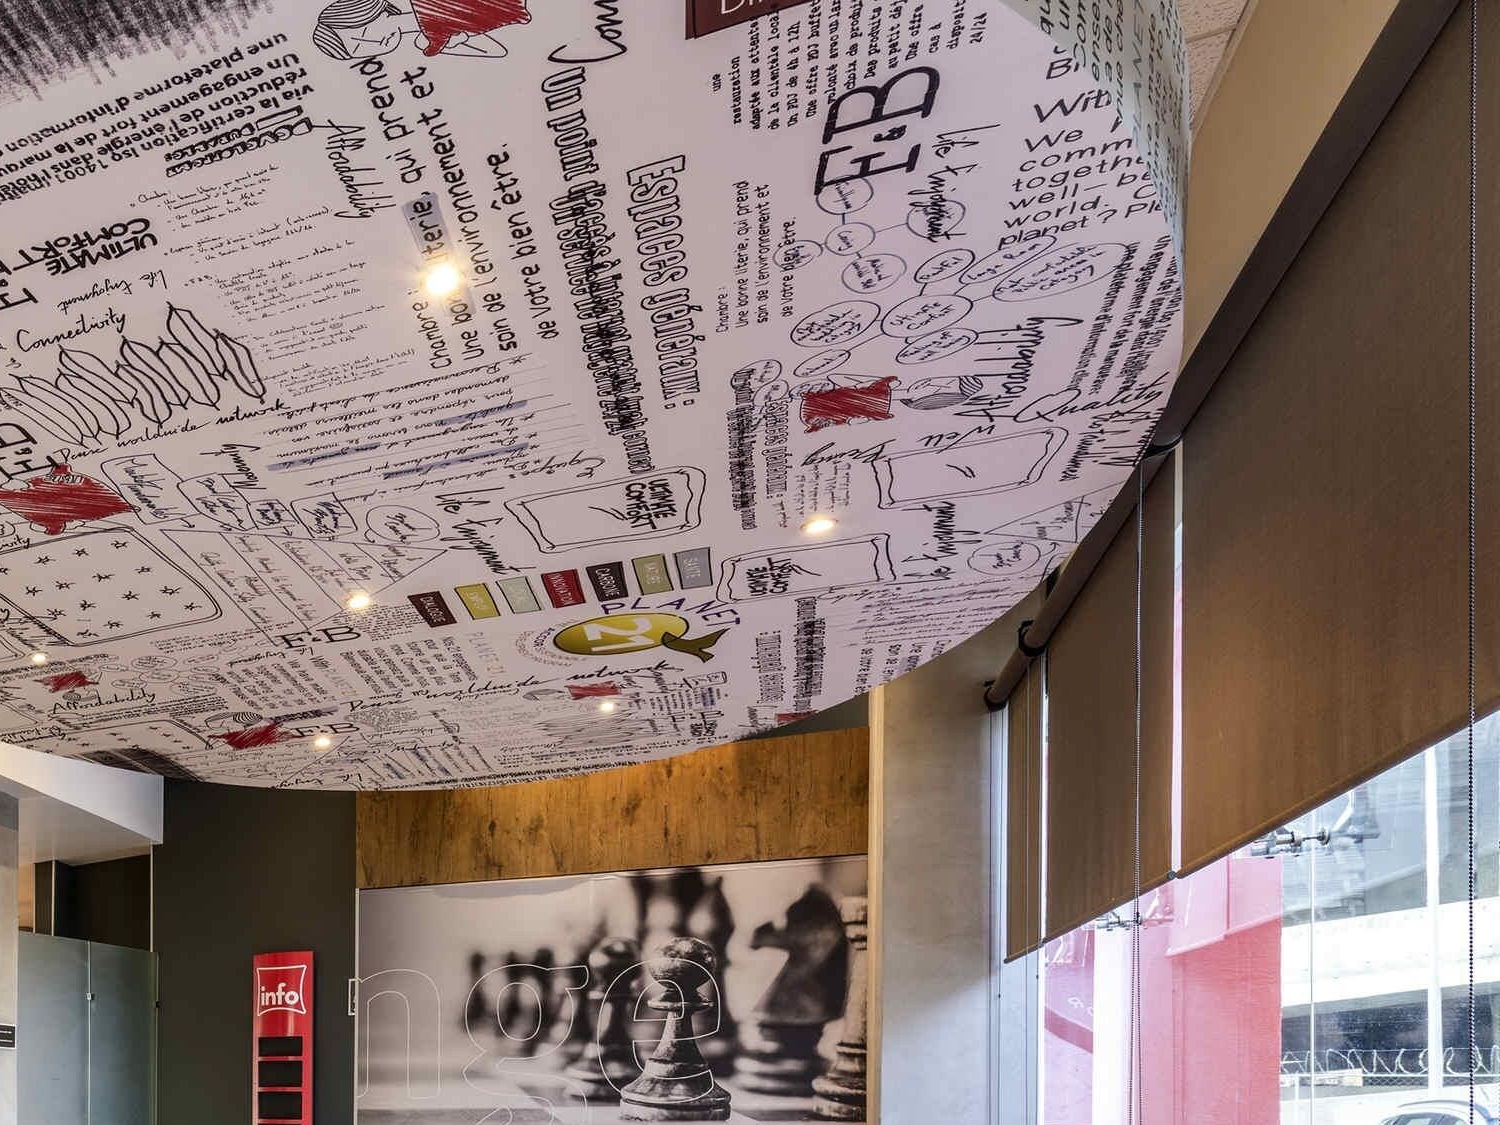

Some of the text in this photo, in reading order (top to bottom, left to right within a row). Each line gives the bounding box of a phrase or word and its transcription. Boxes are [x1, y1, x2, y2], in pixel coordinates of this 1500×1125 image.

[246, 33, 288, 55] une
[266, 53, 300, 69] Un
[133, 46, 242, 100] plateforme
[208, 67, 307, 111] réduction
[281, 84, 314, 100] via
[138, 67, 266, 123] engagement
[258, 96, 280, 109] la
[4, 96, 131, 155] d'information
[101, 117, 138, 141] fort
[137, 98, 255, 151] certification
[179, 108, 205, 122] de
[54, 141, 76, 154] la
[74, 133, 97, 146] de
[109, 142, 139, 162] Iso
[1024, 129, 1083, 152] We
[323, 119, 396, 220] Affordability
[351, 56, 484, 360] Une qui prend
[400, 66, 518, 351] soin de l'environnement et
[1004, 195, 1109, 229] world.
[12, 218, 150, 271] COMFORT
[47, 232, 158, 276] ULTIMATE
[486, 144, 559, 339] de bien être.
[626, 154, 706, 400] Espaces généraux
[16, 307, 126, 357] Connectivity
[412, 301, 452, 369] Chambre
[592, 565, 620, 600] CARBONE
[601, 598, 741, 629] PLANET
[260, 982, 300, 1006] info
